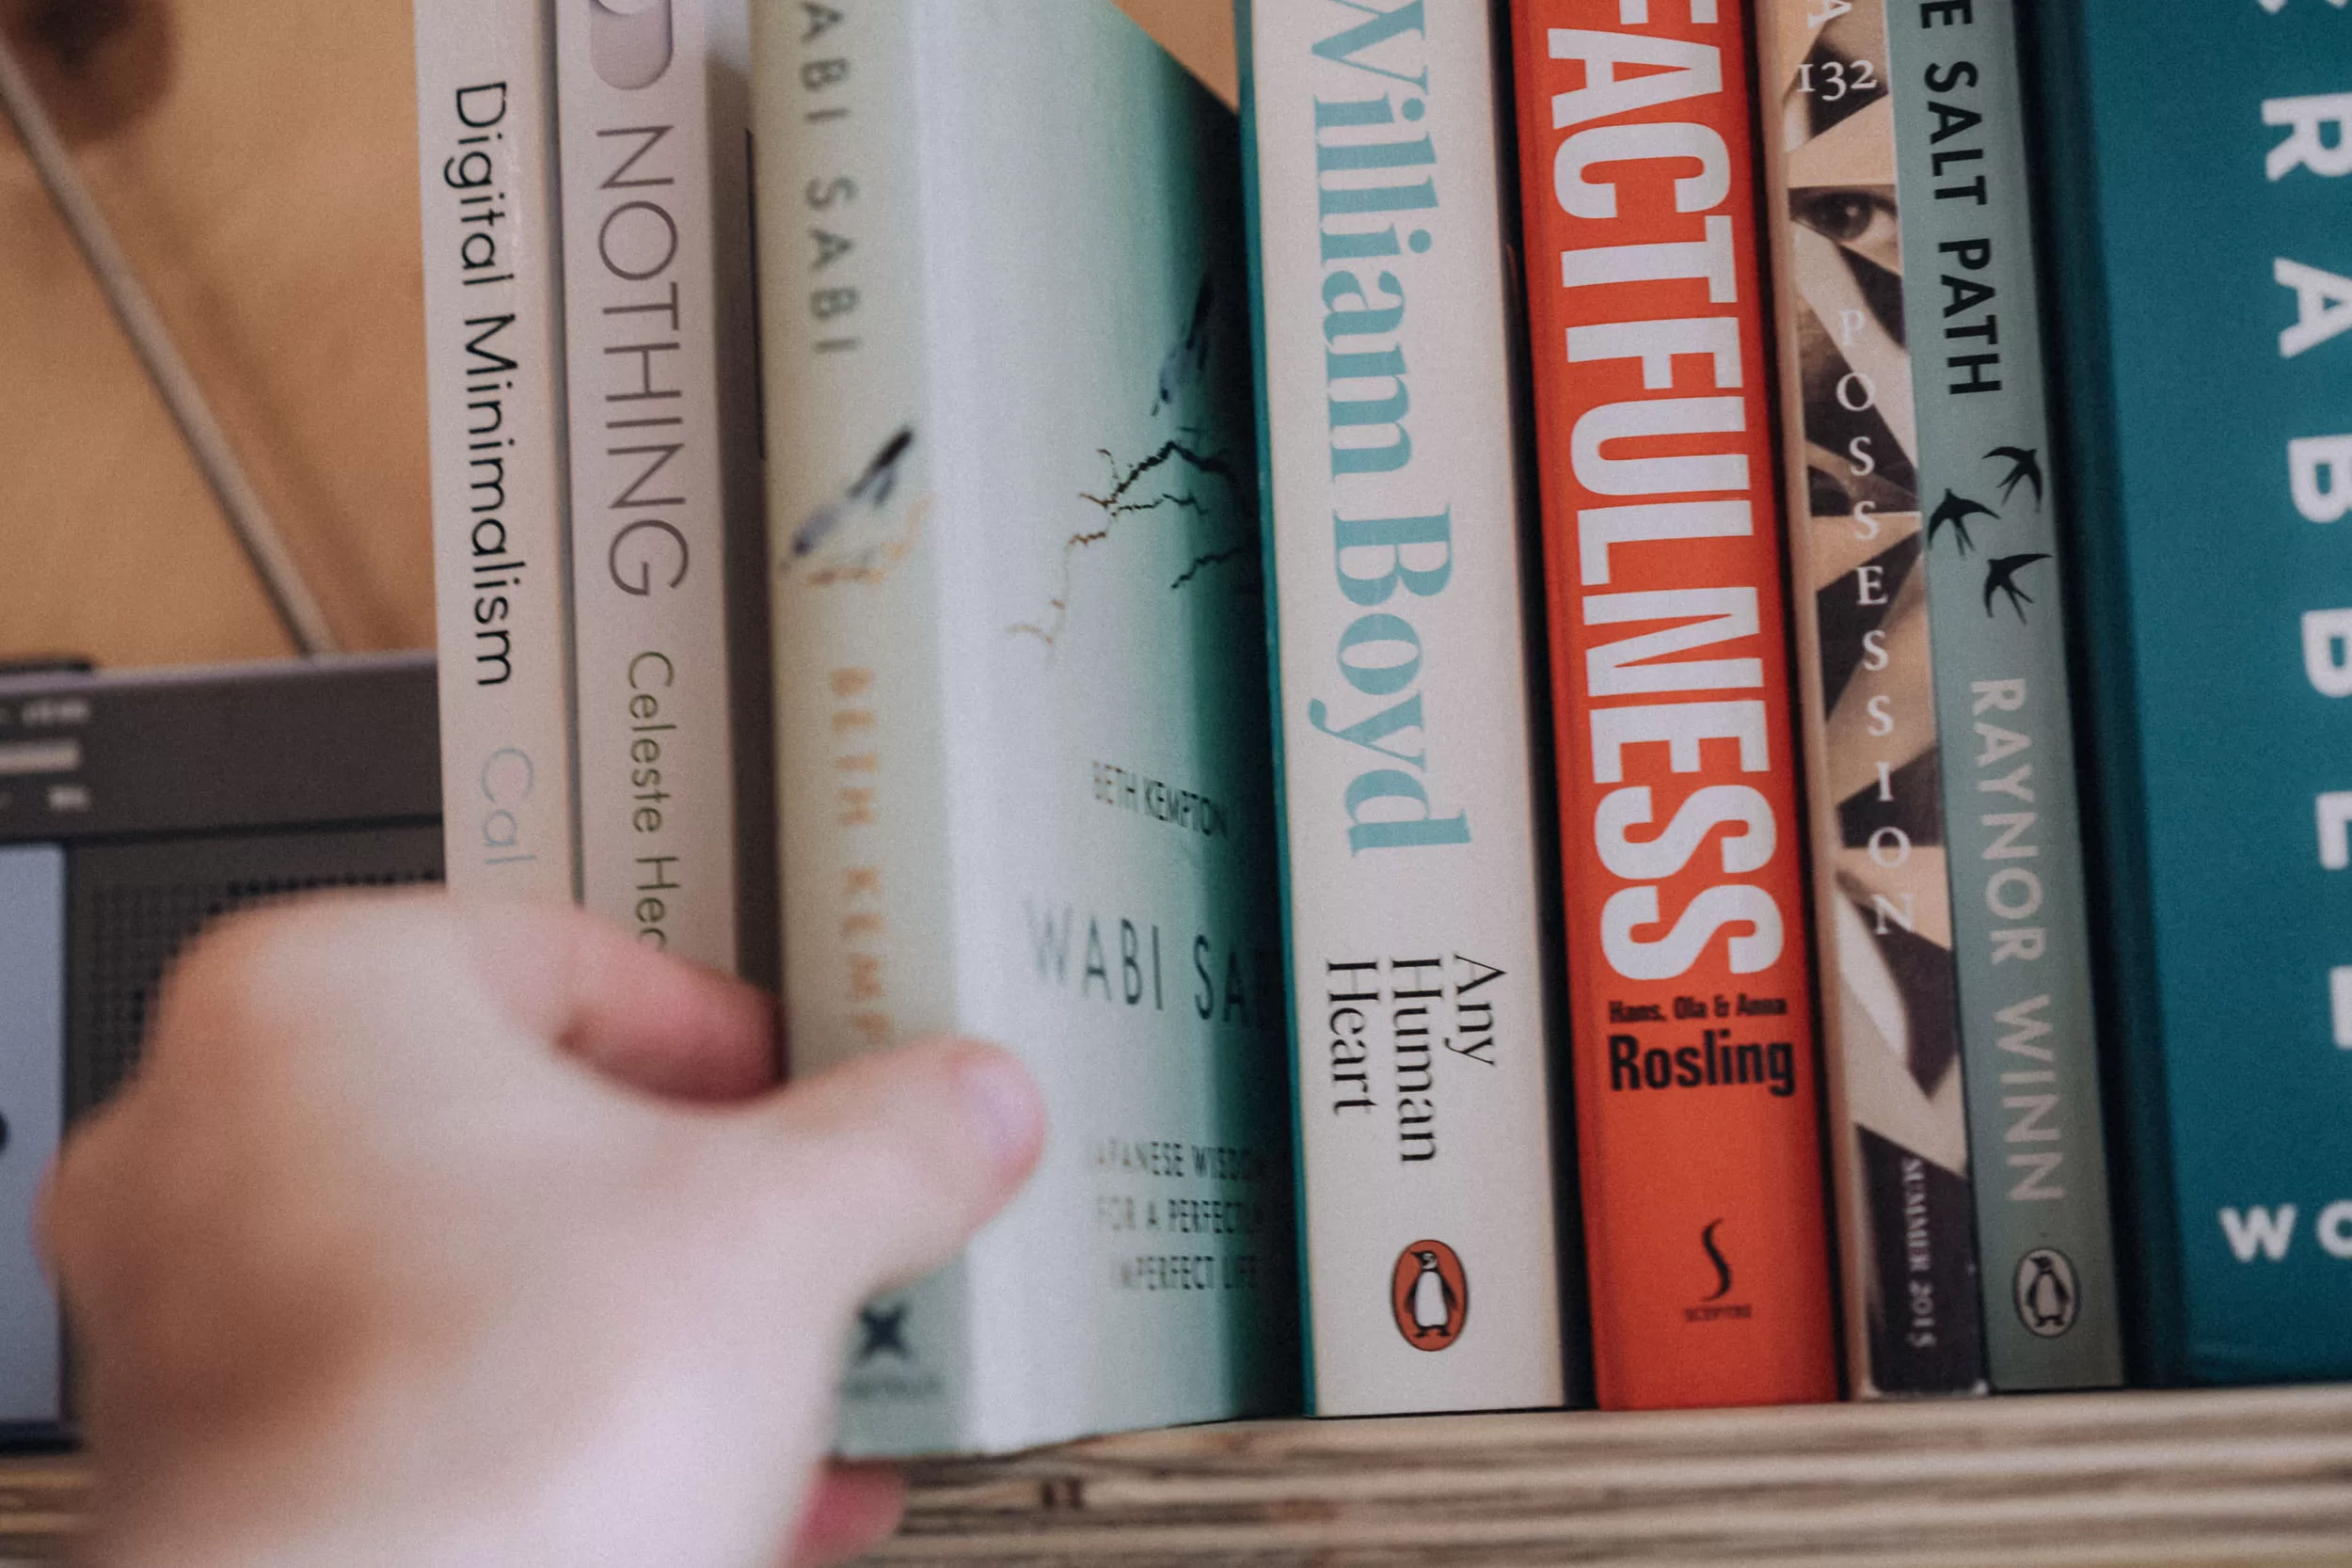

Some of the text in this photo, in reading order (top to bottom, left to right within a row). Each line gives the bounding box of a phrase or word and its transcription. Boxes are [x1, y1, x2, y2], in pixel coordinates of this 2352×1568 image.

[1796, 58, 1878, 102] 132
[1924, 60, 1988, 206] SALT
[800, 0, 859, 355] ABI SABI
[596, 125, 690, 597] NOTHING
[1939, 237, 2002, 396] PATH
[444, 81, 537, 864] Digital Minimalism Cal
[1307, 0, 1472, 858] William Boyd
[1836, 308, 1915, 935] POSSESSION
[628, 651, 677, 834] Celeste
[1022, 898, 1165, 1013] WABI
[1443, 954, 1507, 1066] Any
[1970, 677, 2065, 1204] RAYNOR WINN
[1326, 958, 1379, 1117] Heart
[1390, 953, 1442, 1164] Human
[1609, 1028, 1796, 1098] Rosling
[1901, 1157, 1931, 1272] SUMMER
